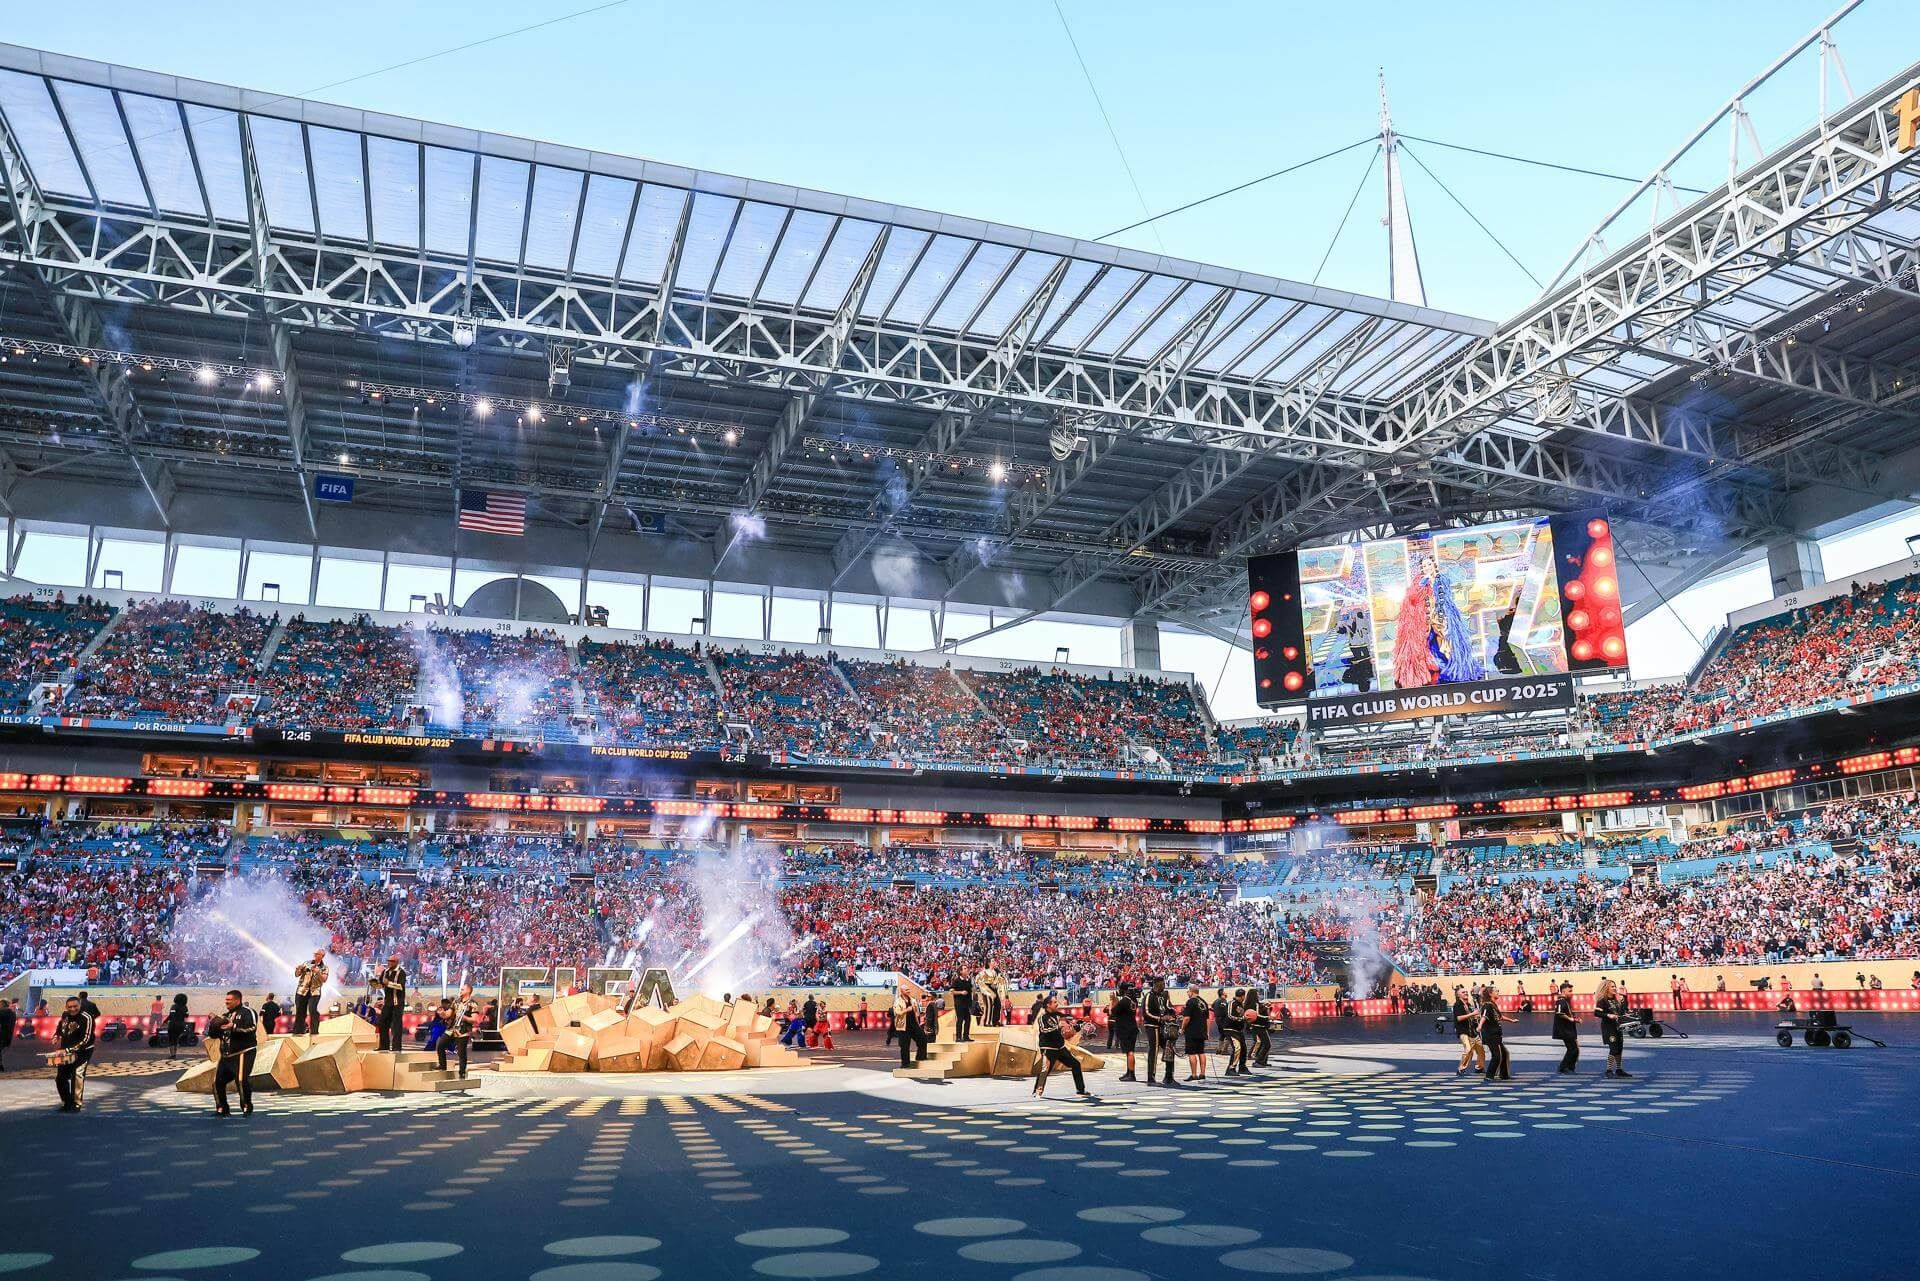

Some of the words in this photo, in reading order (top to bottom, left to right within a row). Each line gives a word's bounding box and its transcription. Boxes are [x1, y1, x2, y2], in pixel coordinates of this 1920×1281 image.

[320, 484, 347, 495] FIFA
[37, 588, 53, 597] 315
[199, 600, 216, 609] 316
[1783, 597, 1798, 607] 328
[496, 623, 511, 631] 318
[633, 633, 646, 642] 319
[761, 643, 776, 652] 320
[883, 652, 896, 661] 321
[999, 661, 1012, 669] 322
[1621, 681, 1637, 690] 327
[1311, 703, 1348, 721] FIFA
[1352, 699, 1396, 717] CLUB
[1402, 693, 1466, 712] WORLD
[1470, 687, 1507, 705] CUP
[26, 716, 42, 725] 42
[133, 721, 151, 731] JOE
[153, 722, 187, 733] ROBBIE
[1714, 726, 1724, 735] 73
[281, 730, 312, 742] 12:45
[344, 734, 362, 744] FIFA
[363, 735, 383, 745] CLUB
[385, 735, 413, 746] WORLD
[414, 737, 430, 747] CUP
[591, 746, 607, 756] FIFA
[607, 747, 627, 757] CLUB
[628, 748, 654, 758] WORLD
[655, 749, 670, 759] CUP
[1530, 750, 1572, 760] RICHMOND
[1603, 746, 1614, 754] 78
[720, 753, 746, 763] 12:45
[818, 757, 836, 766] DON
[838, 758, 861, 768] SHULA
[1467, 756, 1479, 765] 67
[917, 762, 935, 771] NICK
[937, 763, 983, 773] BUONICONTI
[989, 765, 999, 773] 85
[1041, 768, 1055, 776] BILL
[1057, 768, 1101, 778] ARNSPARGER
[1261, 773, 1290, 782] DWIGHT
[1293, 768, 1339, 779] STEPHENSON
[1342, 767, 1352, 776] 57
[1194, 775, 1204, 783] 66
